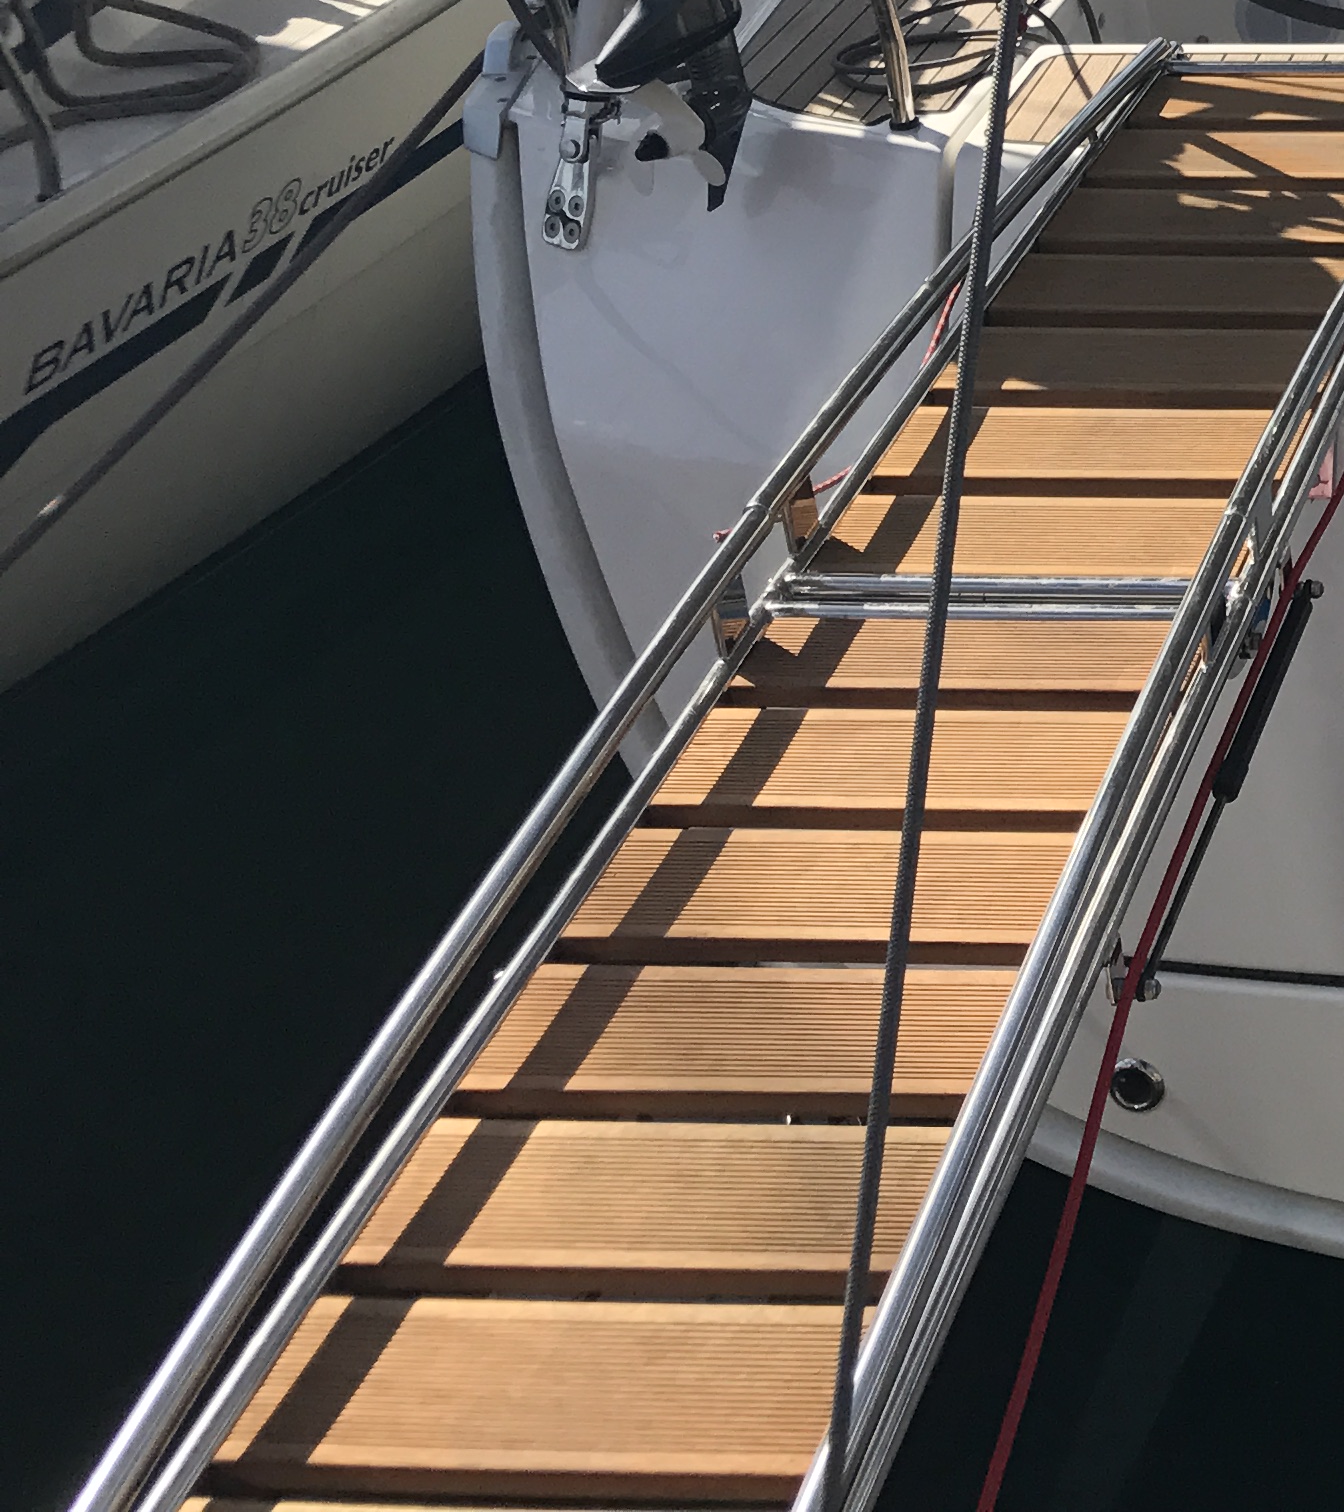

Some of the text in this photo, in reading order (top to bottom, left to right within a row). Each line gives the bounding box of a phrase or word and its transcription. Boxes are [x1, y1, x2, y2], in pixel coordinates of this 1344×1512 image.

[25, 136, 395, 395] BAVARIA 38 cruiser
